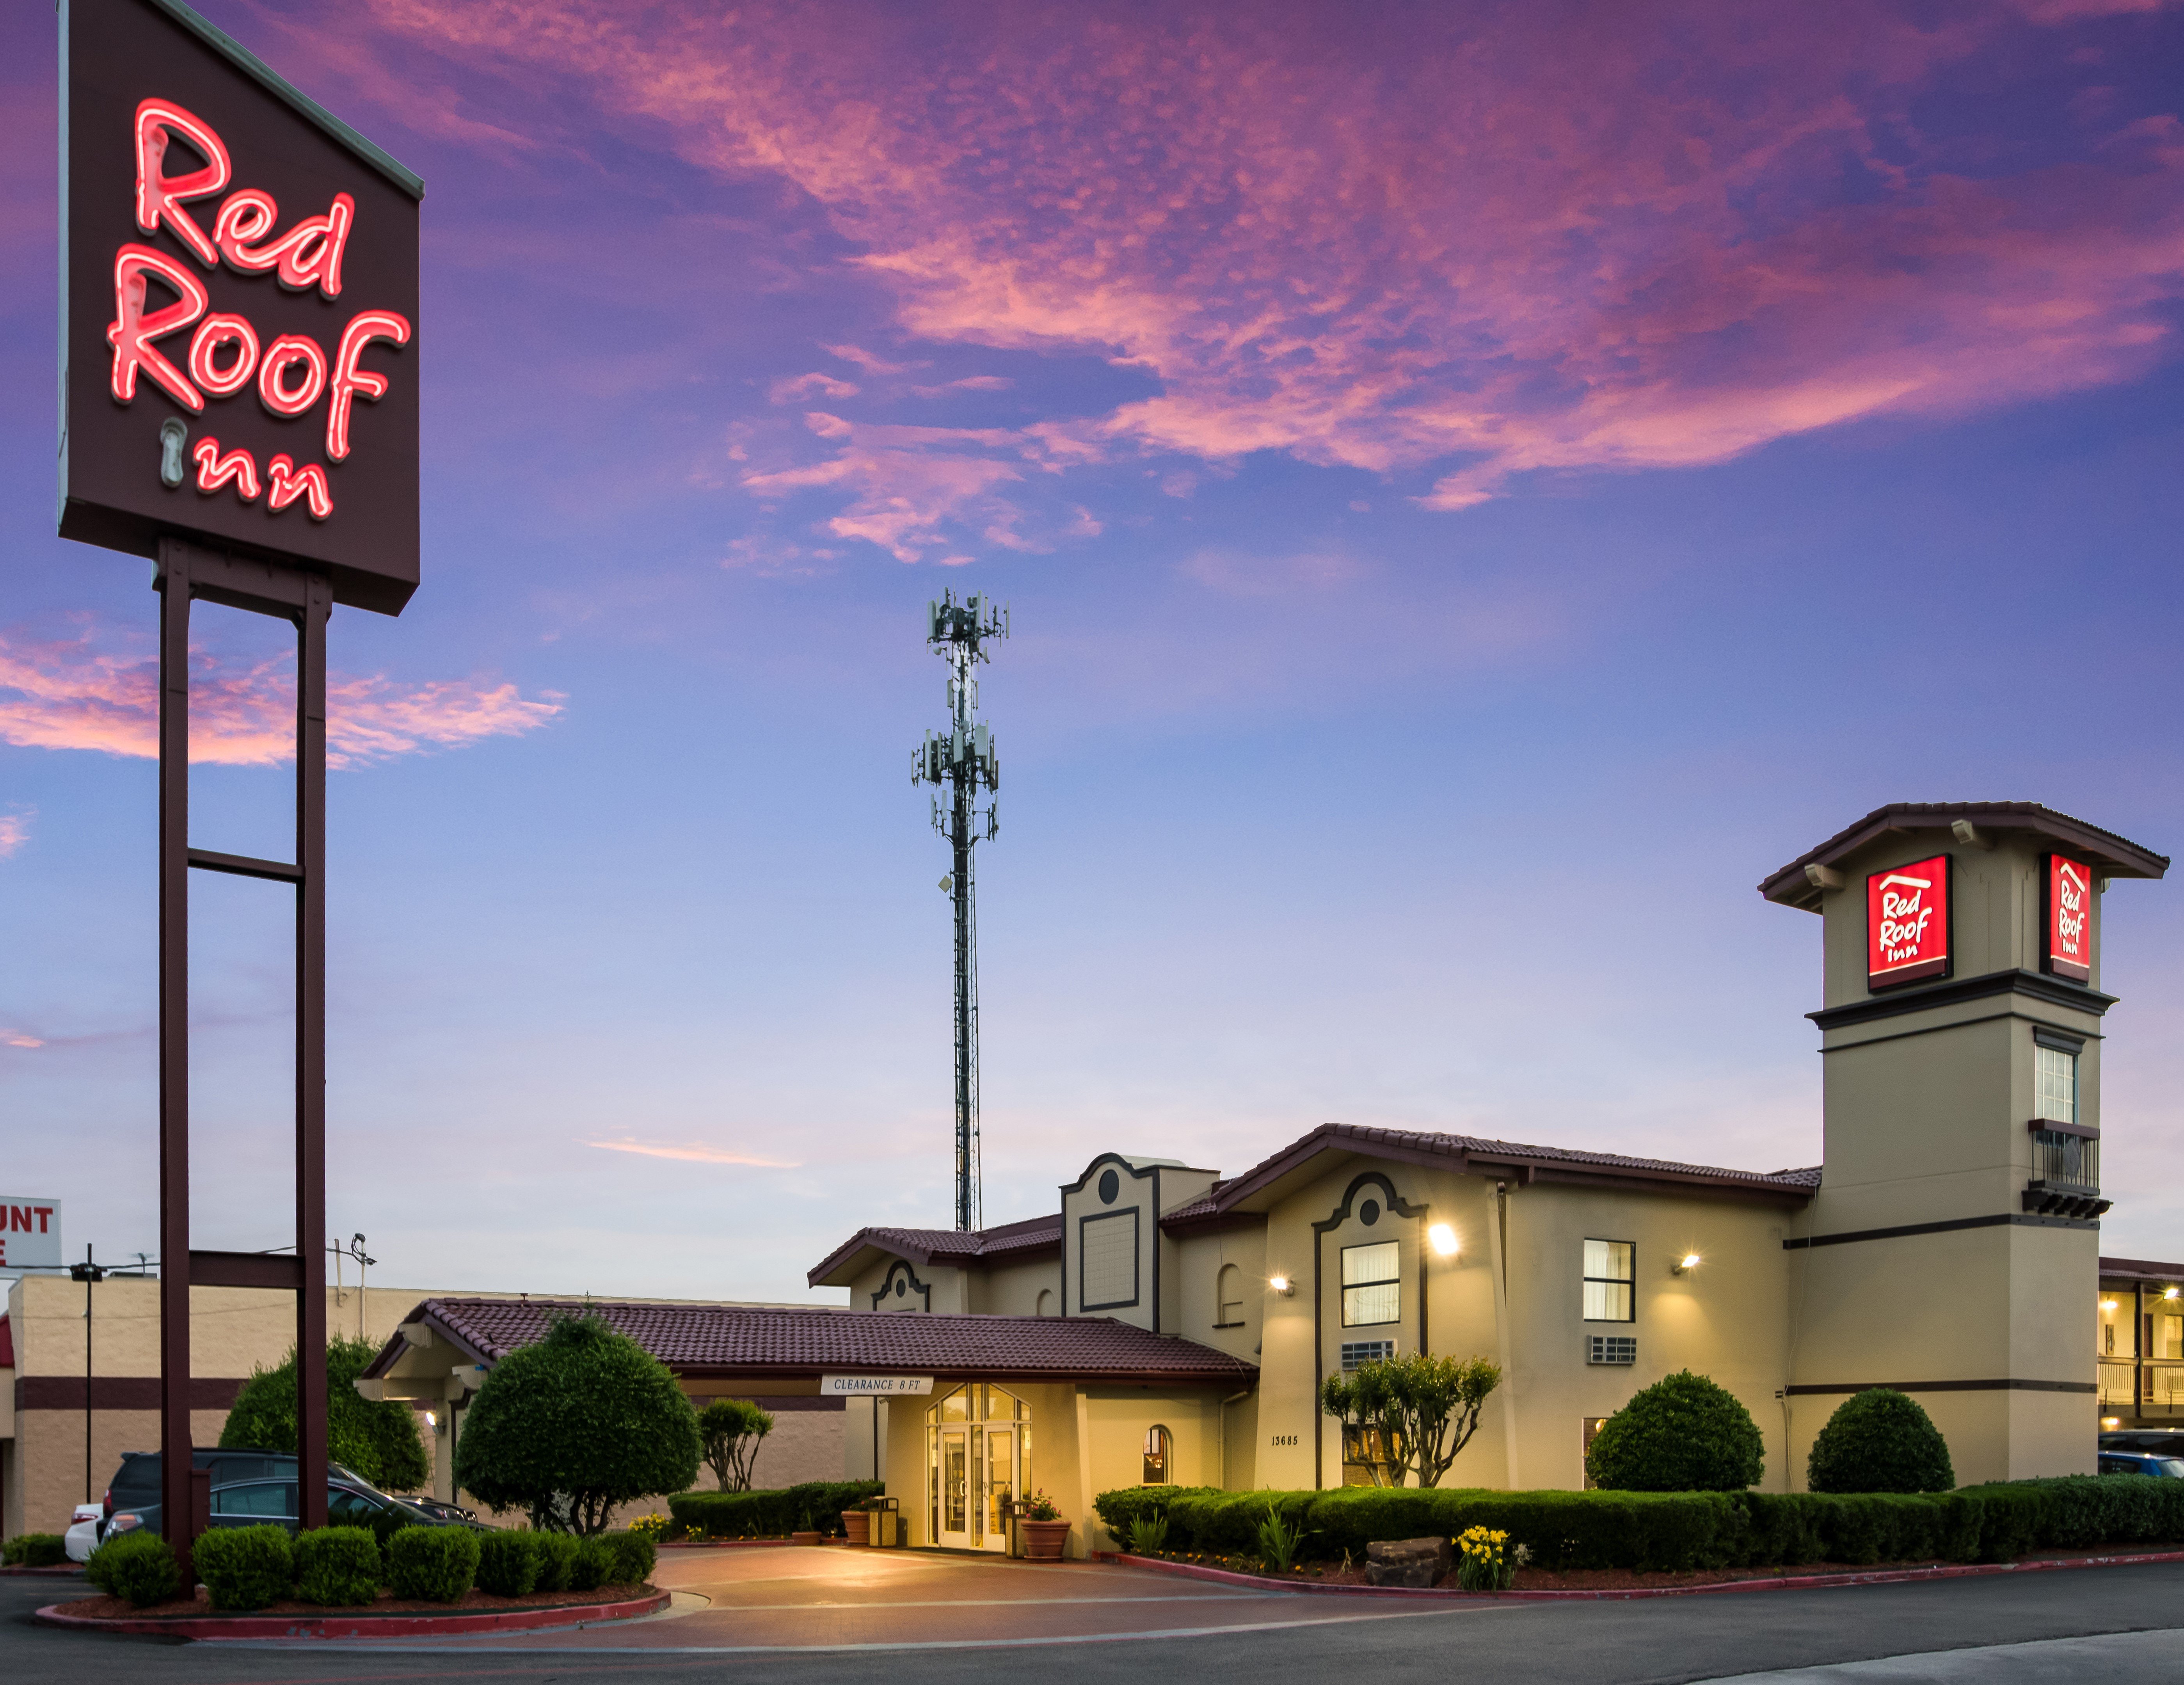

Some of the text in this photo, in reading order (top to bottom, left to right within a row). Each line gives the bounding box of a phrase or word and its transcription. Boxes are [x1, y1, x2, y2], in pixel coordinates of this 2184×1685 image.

[133, 97, 355, 300] Red
[106, 242, 411, 464] Roof
[1883, 889, 1921, 919] Red
[2061, 879, 2080, 912] Red
[1879, 906, 1932, 952] Roof
[2058, 907, 2085, 944] Roof
[834, 1378, 921, 1390] CLEARANCE 8 FT
[1272, 1435, 1298, 1446] 13685
